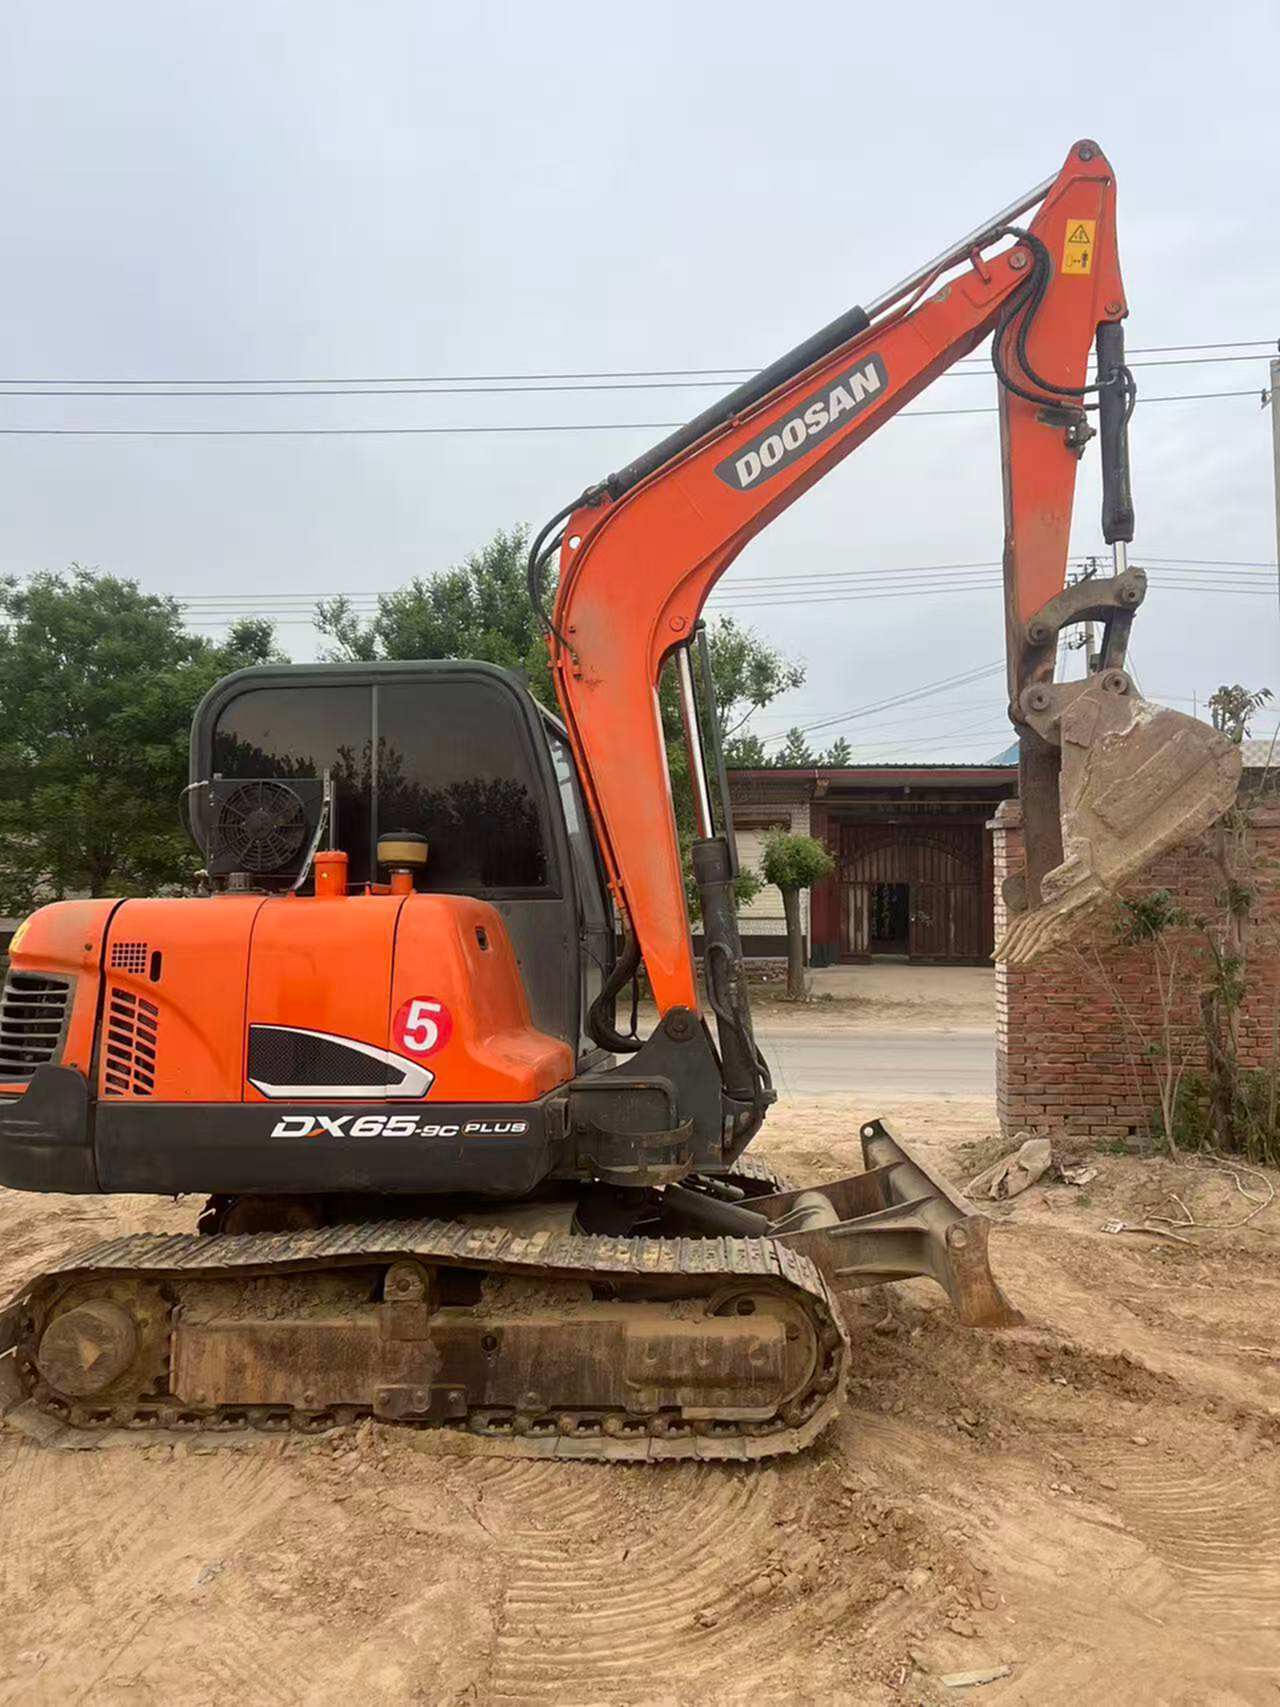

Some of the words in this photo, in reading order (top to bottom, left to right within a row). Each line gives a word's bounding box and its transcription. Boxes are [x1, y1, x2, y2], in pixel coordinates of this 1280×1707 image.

[735, 363, 881, 488] DOOSAN
[403, 1000, 441, 1051] 5
[464, 1122, 527, 1134] PLUS
